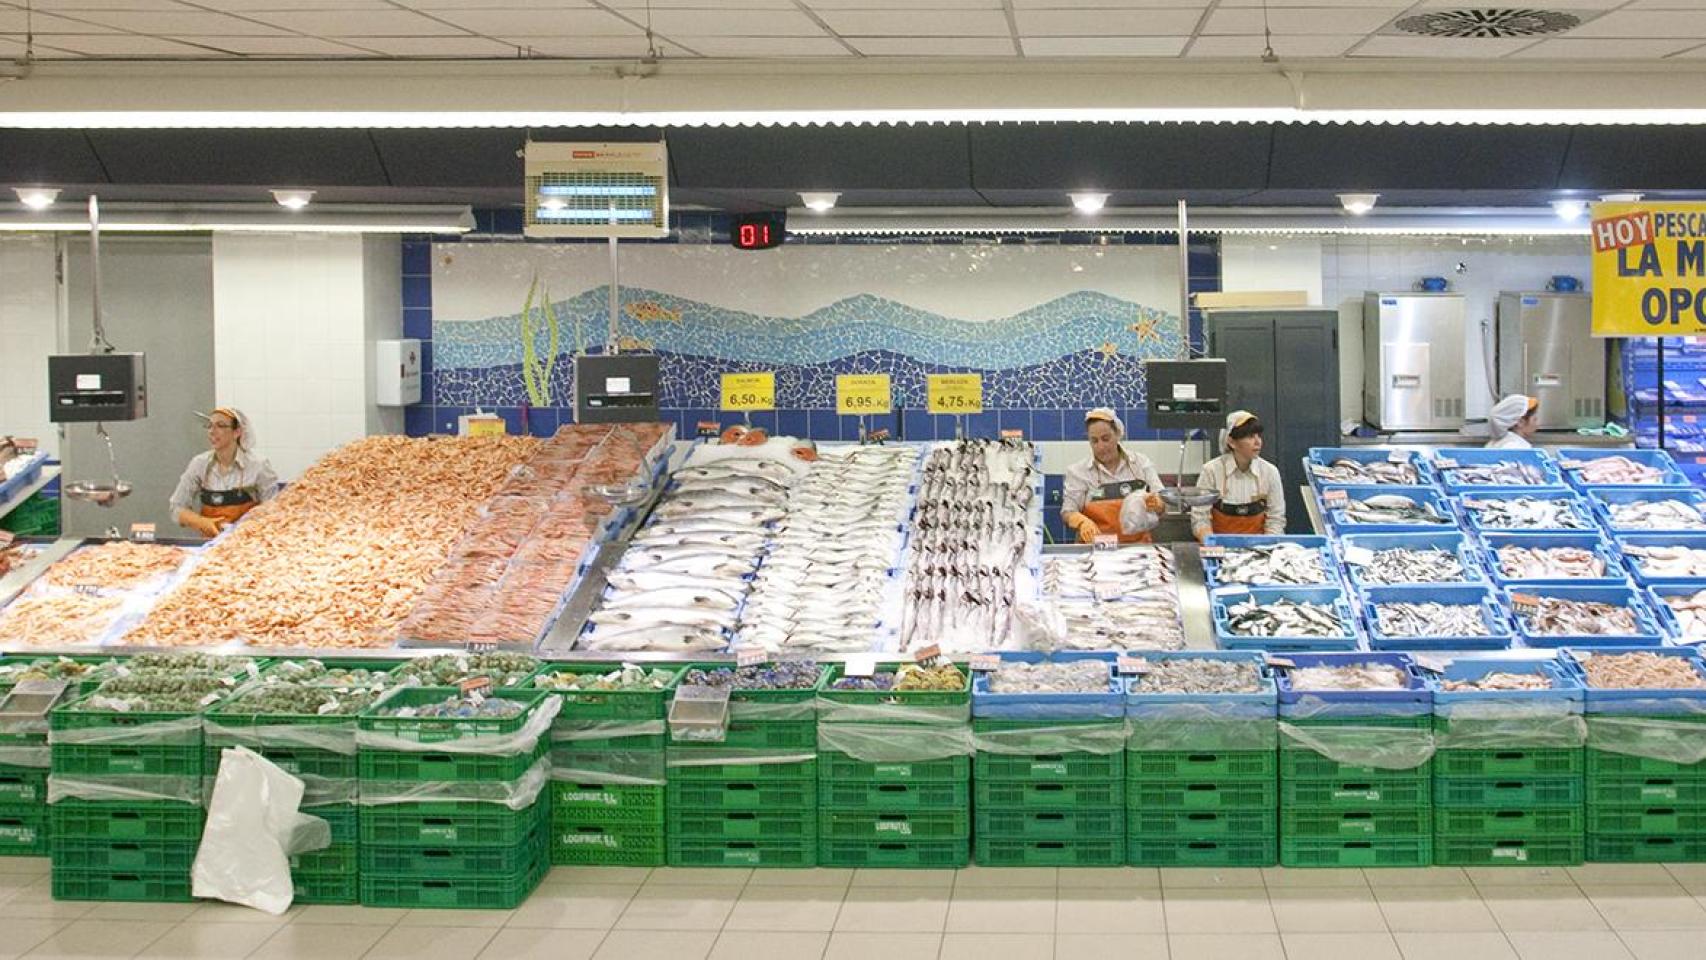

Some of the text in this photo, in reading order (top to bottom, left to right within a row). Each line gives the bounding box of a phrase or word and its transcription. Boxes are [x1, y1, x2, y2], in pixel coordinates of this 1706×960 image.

[740, 224, 769, 247] 01
[1597, 215, 1649, 250] HOY
[1618, 241, 1663, 277] LA
